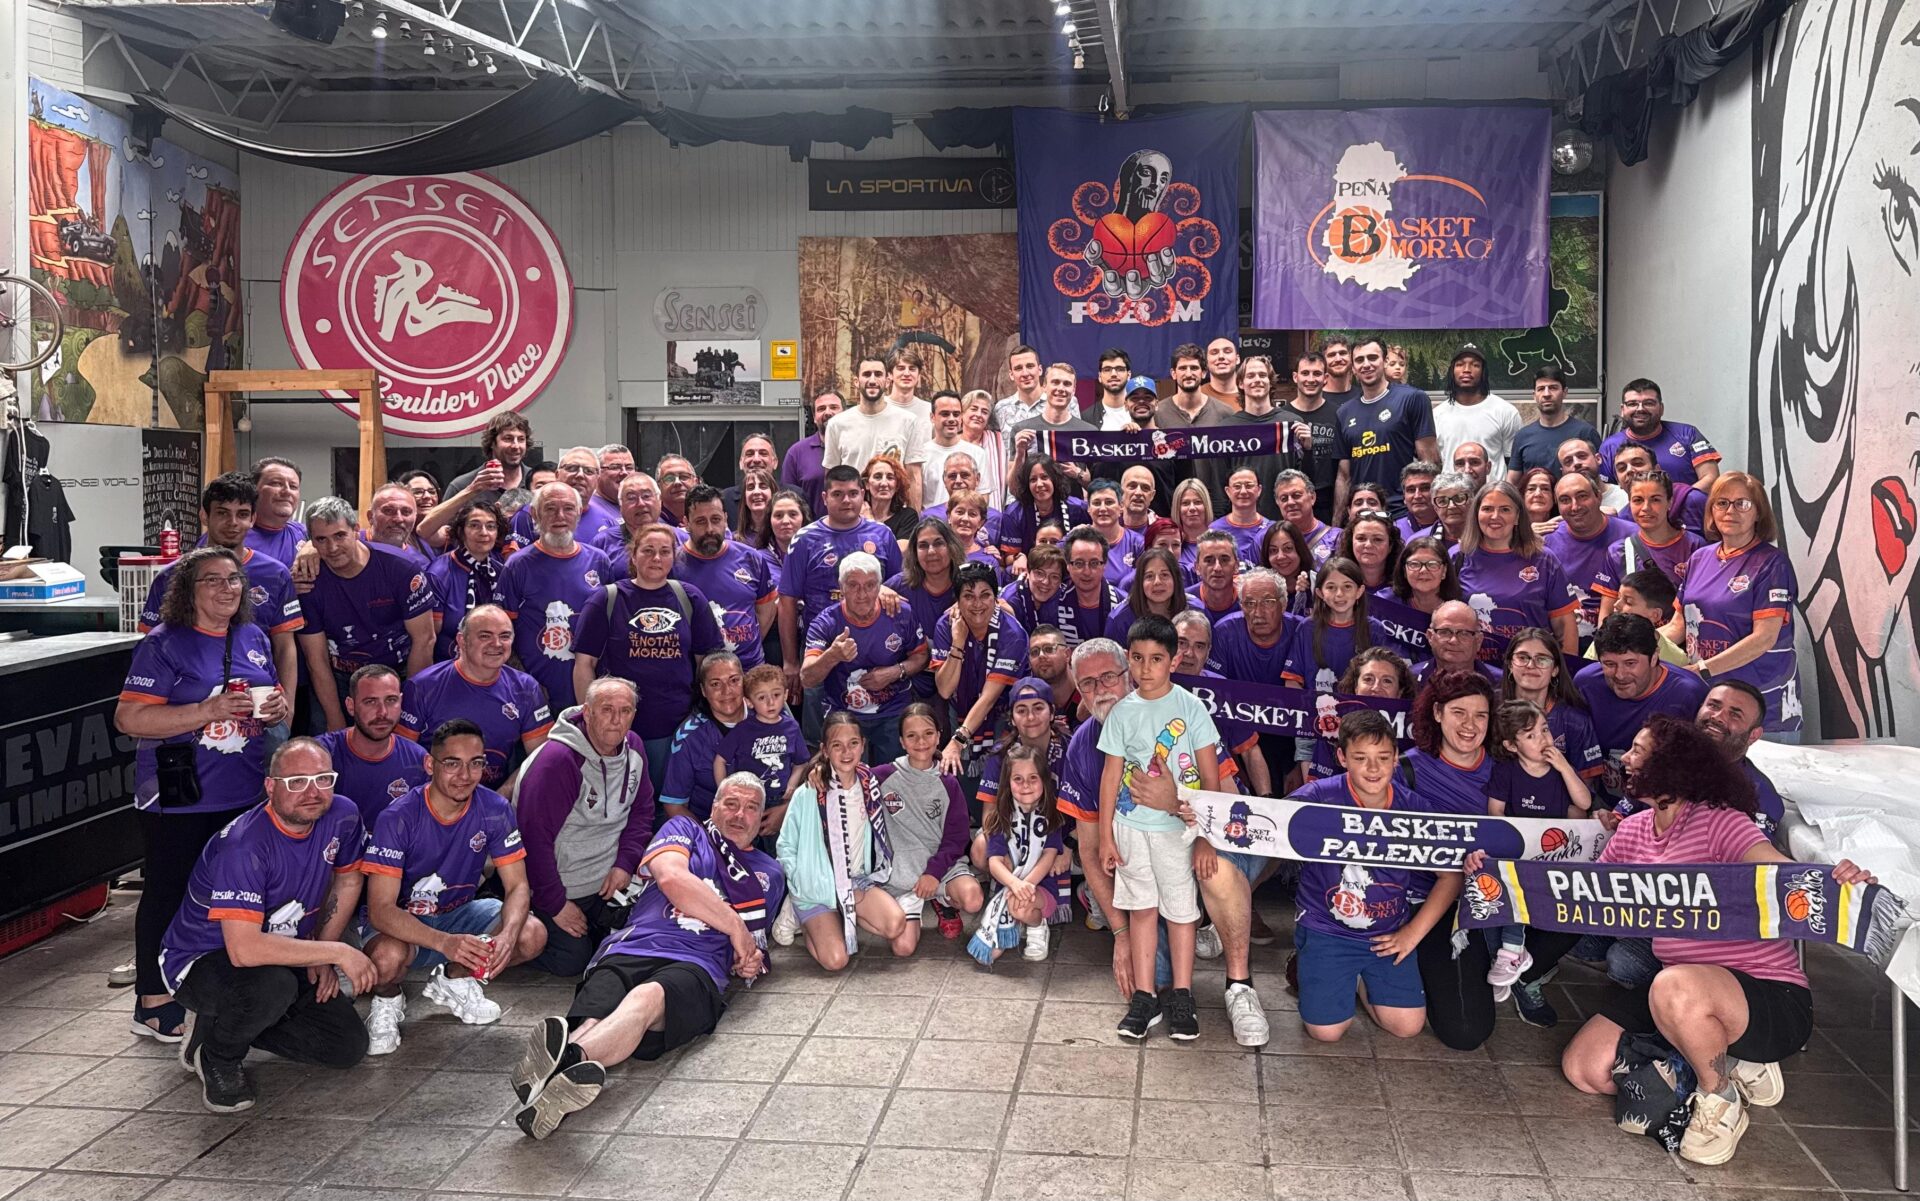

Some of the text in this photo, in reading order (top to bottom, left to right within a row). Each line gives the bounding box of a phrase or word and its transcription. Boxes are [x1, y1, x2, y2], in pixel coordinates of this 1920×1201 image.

[826, 179, 973, 194] LA SPORTIVA
[1338, 178, 1389, 197] PEÑA
[477, 342, 543, 400] Place
[1072, 434, 1261, 458] BASKET MORAO
[1351, 443, 1390, 458] agropal
[102, 477, 139, 487] WORLD
[628, 631, 638, 639] SE
[639, 635, 670, 648] NOTA
[671, 640, 680, 648] LA
[629, 647, 682, 658] MORADA
[128, 675, 155, 688] 2008
[1191, 686, 1309, 729] BASKET
[400, 711, 418, 725] 008
[1341, 812, 1478, 842] BASKET
[1320, 837, 1468, 866] PALENCI
[1547, 869, 1719, 907] PALENCIA
[1556, 902, 1721, 931] BALONCESTO
[270, 920, 298, 933] PEÑA
